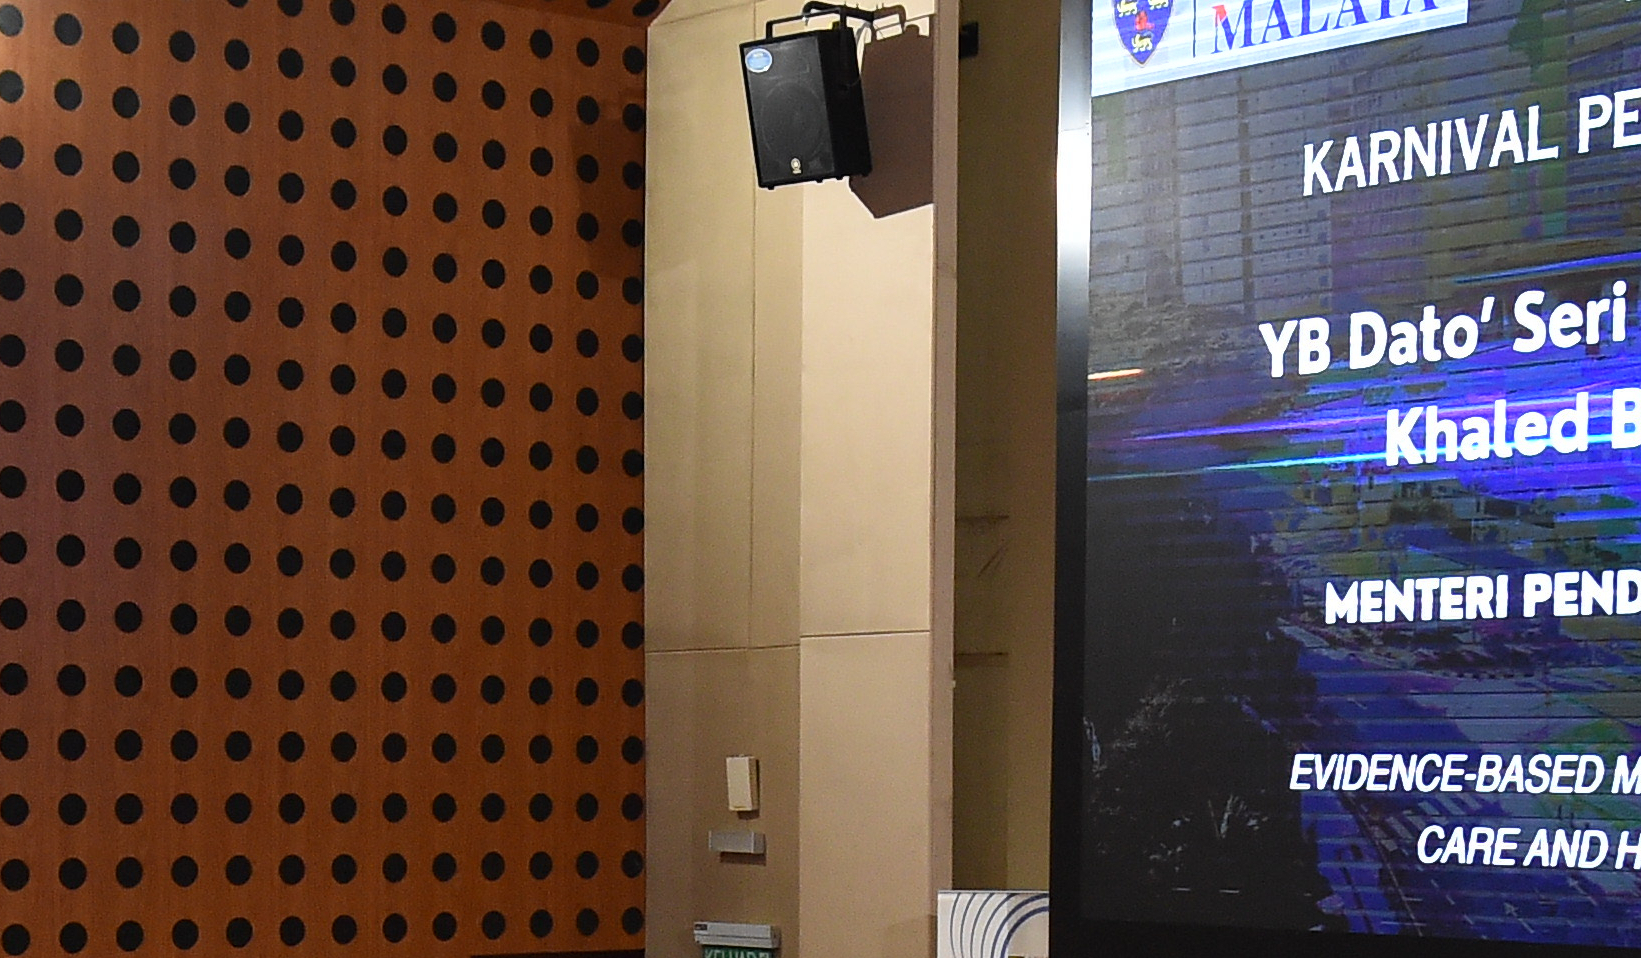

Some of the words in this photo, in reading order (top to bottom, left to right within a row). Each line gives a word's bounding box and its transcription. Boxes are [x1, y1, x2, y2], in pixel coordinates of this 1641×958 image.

[1210, 0, 1440, 54] MALA
[1302, 104, 1559, 197] KARNIVAL
[1258, 317, 1331, 378] YB
[1512, 280, 1627, 353] Seri
[1385, 392, 1589, 467] Khaled
[1325, 577, 1509, 625] MENTERI
[1289, 753, 1605, 795] EVIDENCE-BASED
[1417, 824, 1522, 867] CARE
[1521, 827, 1609, 869] AND
